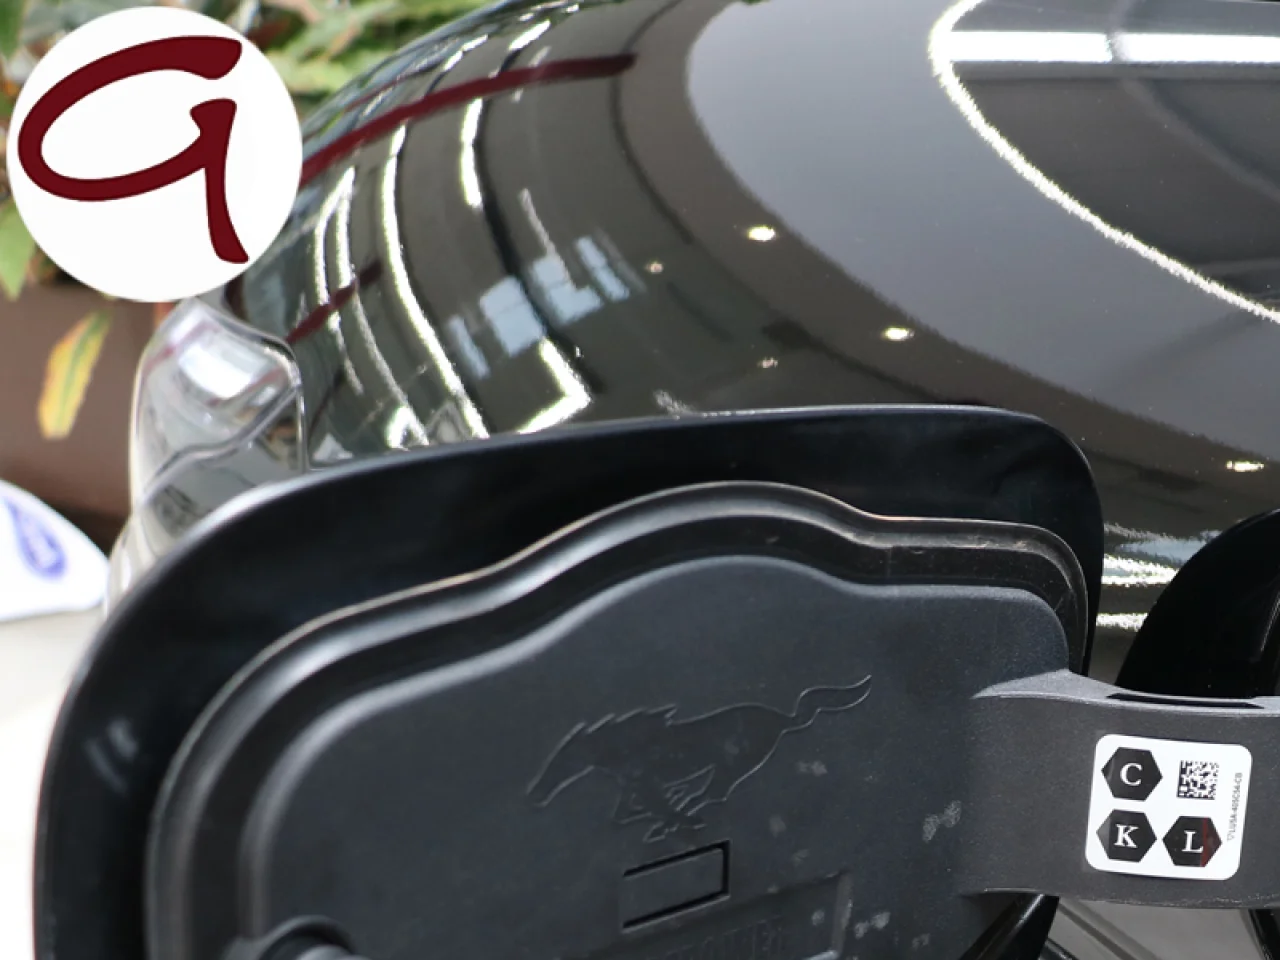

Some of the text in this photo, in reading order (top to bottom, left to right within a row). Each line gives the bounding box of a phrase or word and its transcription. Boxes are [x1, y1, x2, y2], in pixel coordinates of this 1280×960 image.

[1120, 763, 1142, 786] C
[1113, 824, 1204, 853] K L
